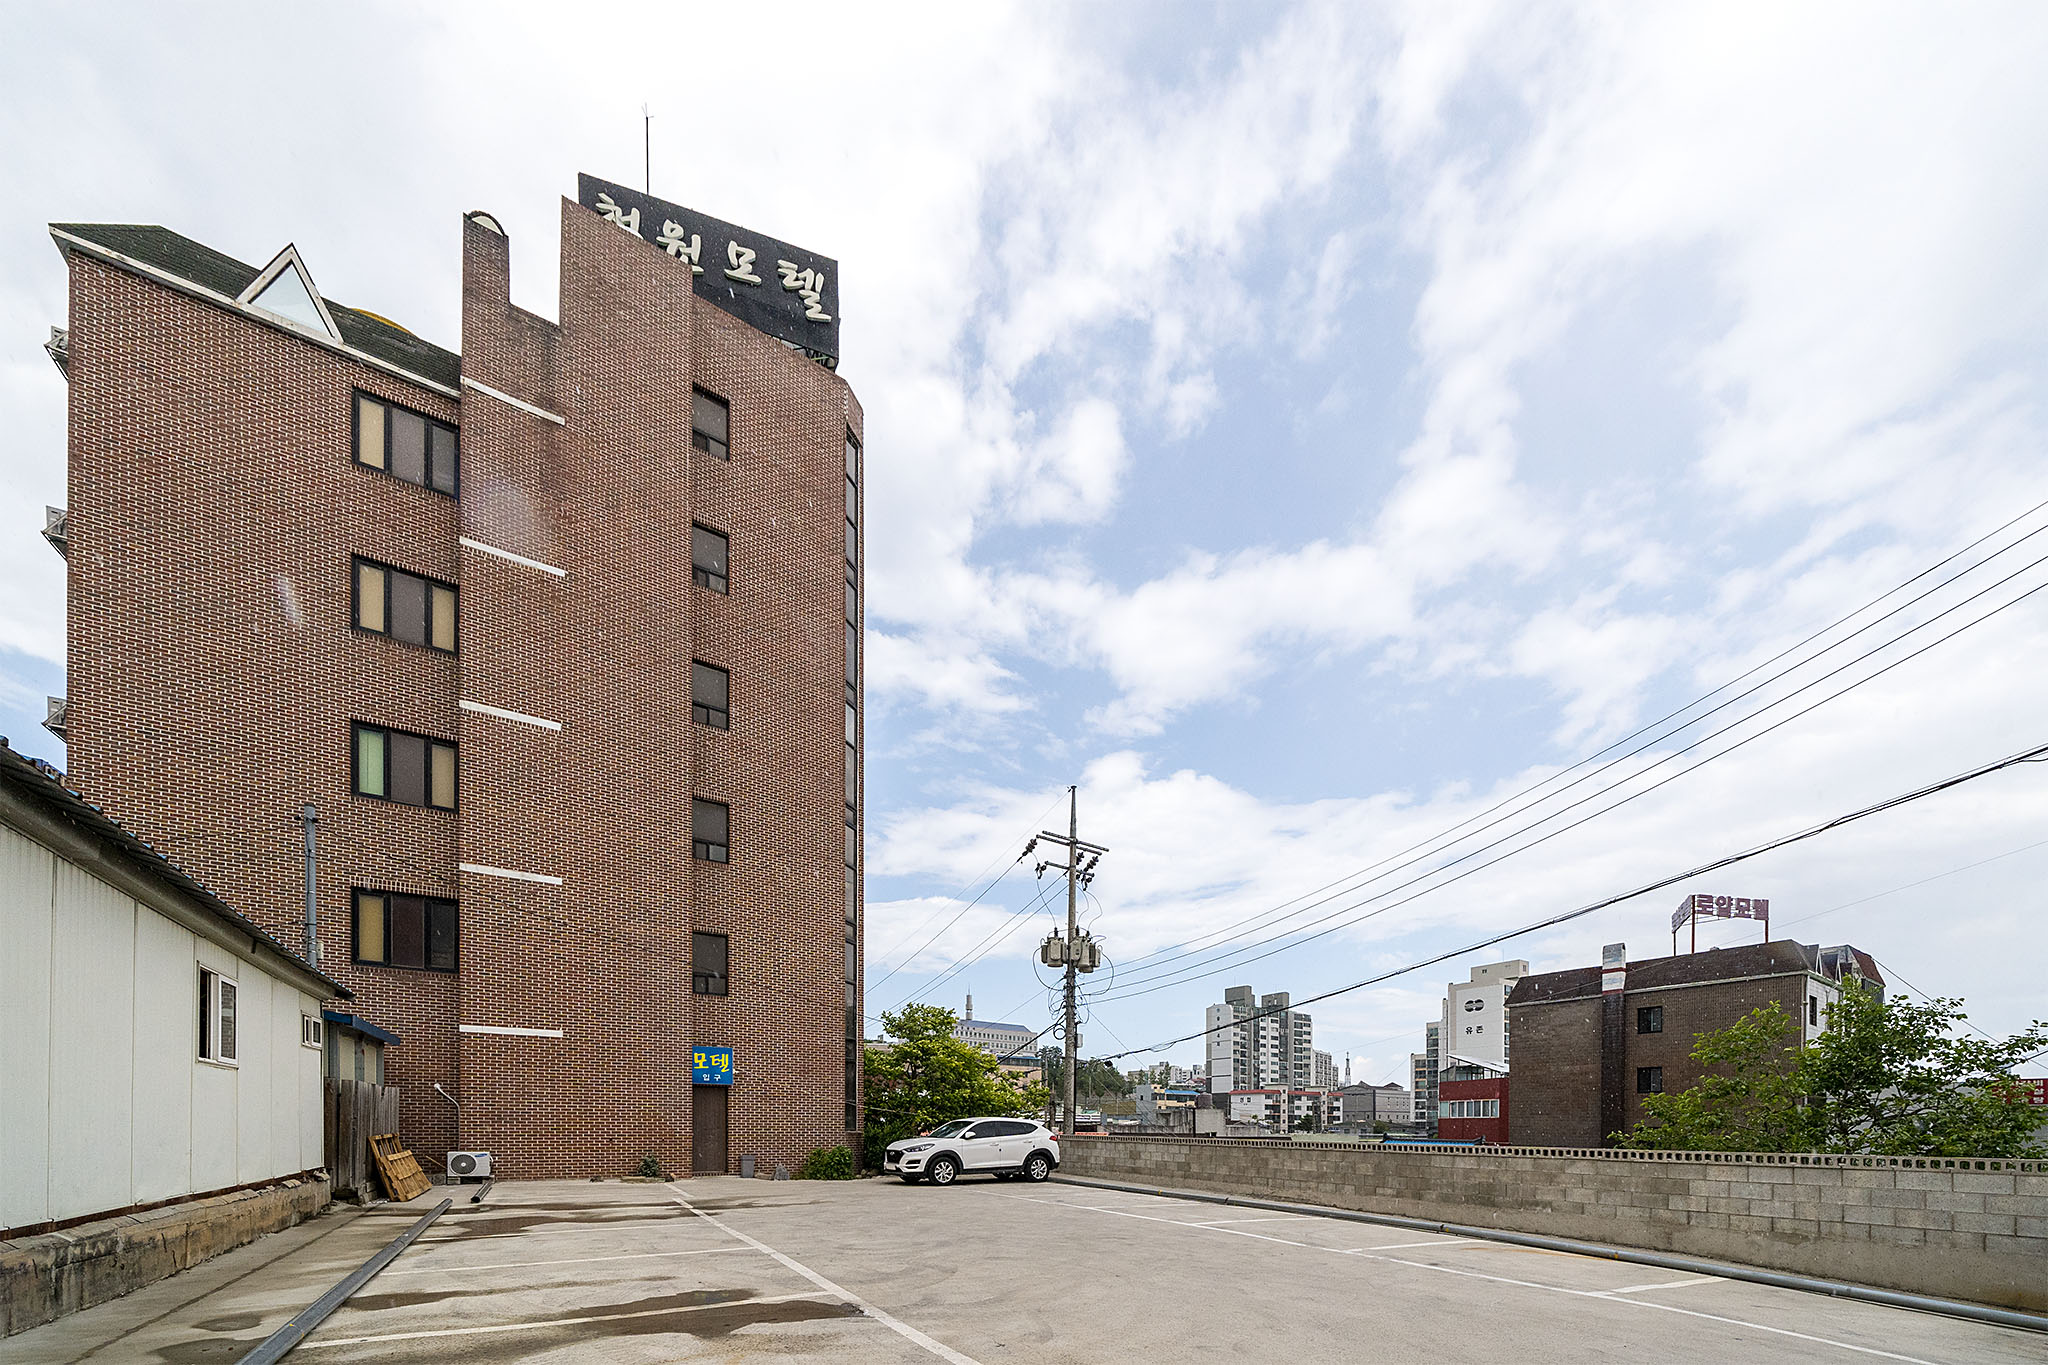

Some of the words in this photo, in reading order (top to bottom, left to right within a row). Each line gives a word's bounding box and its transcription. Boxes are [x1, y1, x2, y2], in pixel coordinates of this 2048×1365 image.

[1696, 894, 1769, 920] 로얄모텔
[693, 1052, 730, 1073] 모텔
[702, 1073, 721, 1082] 입구
